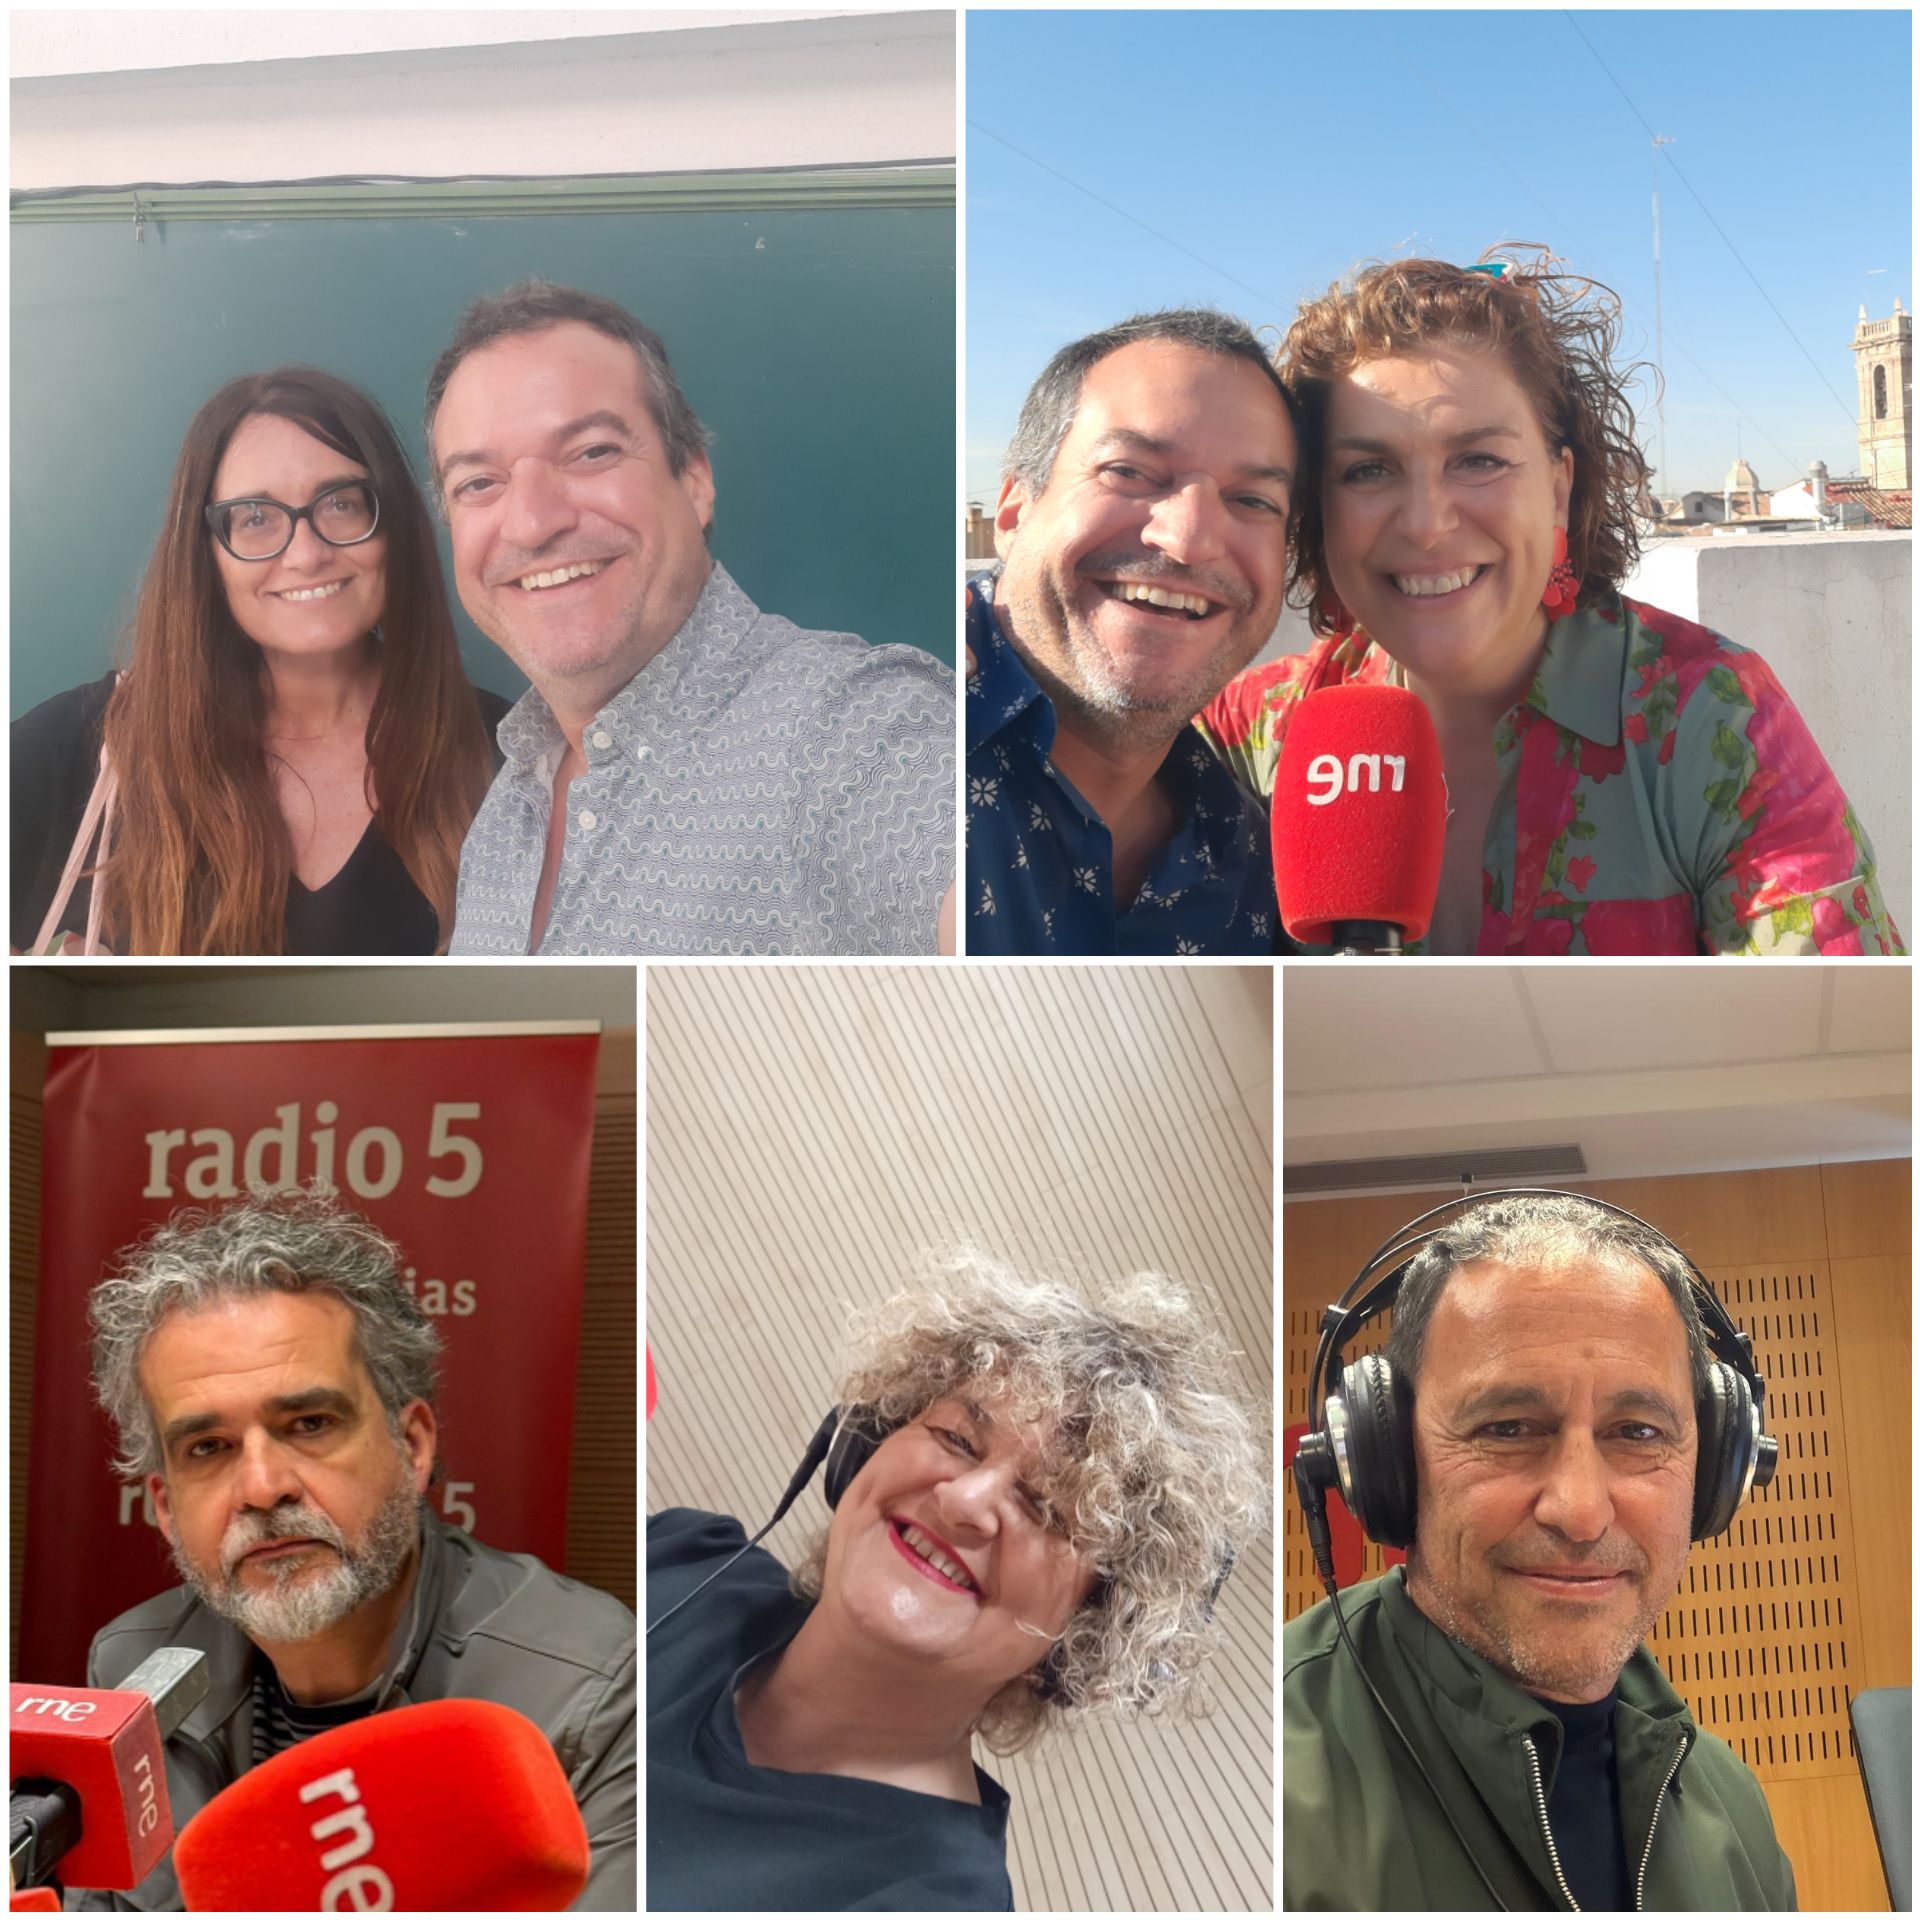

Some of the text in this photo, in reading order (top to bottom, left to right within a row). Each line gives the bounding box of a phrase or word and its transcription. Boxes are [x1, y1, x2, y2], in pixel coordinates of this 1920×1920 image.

[143, 1100, 484, 1200] radio 5
[15, 1697, 97, 1723] rne
[134, 1754, 158, 1838] rne
[299, 1767, 395, 1912] rne
